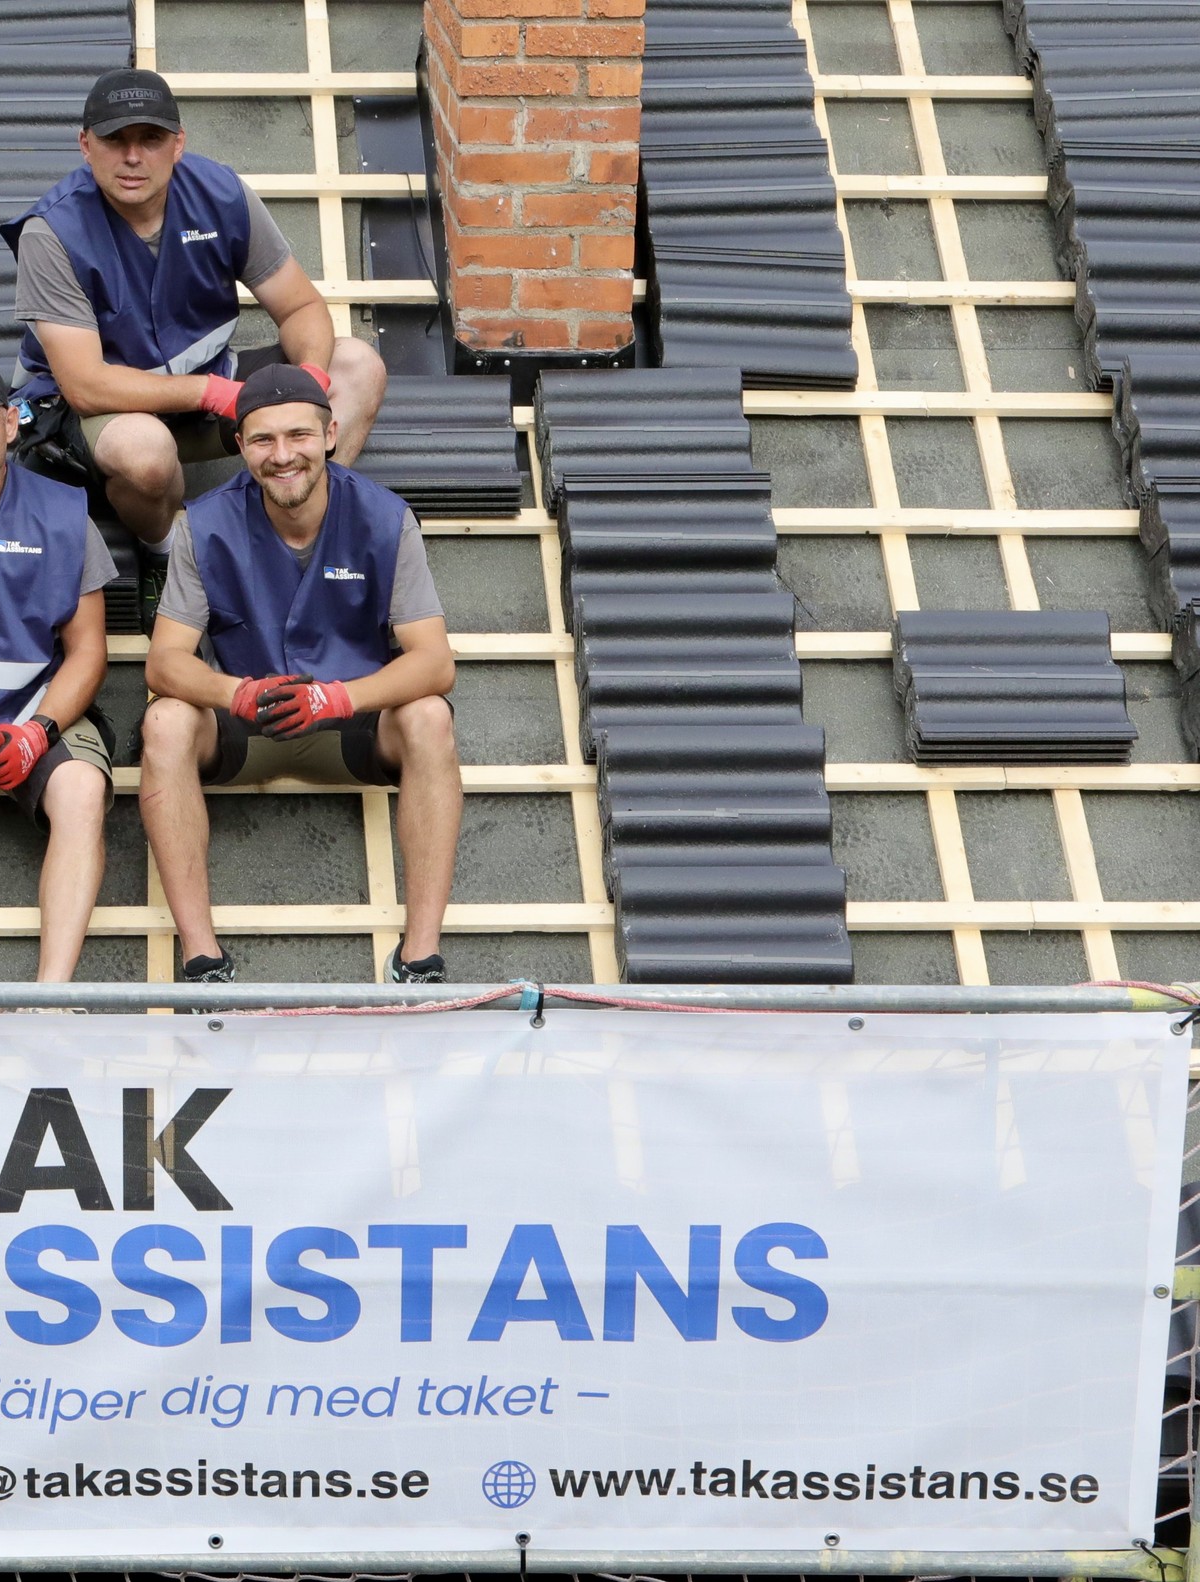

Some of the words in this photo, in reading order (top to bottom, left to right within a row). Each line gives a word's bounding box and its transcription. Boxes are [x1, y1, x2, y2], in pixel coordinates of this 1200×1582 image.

[120, 90, 161, 99] BYGMA
[6, 546, 42, 554] ASSISTANS
[160, 1374, 250, 1429] dig
[266, 1375, 401, 1418] med
[416, 1374, 560, 1417] taket
[548, 1459, 1099, 1504] www.takassistans.se
